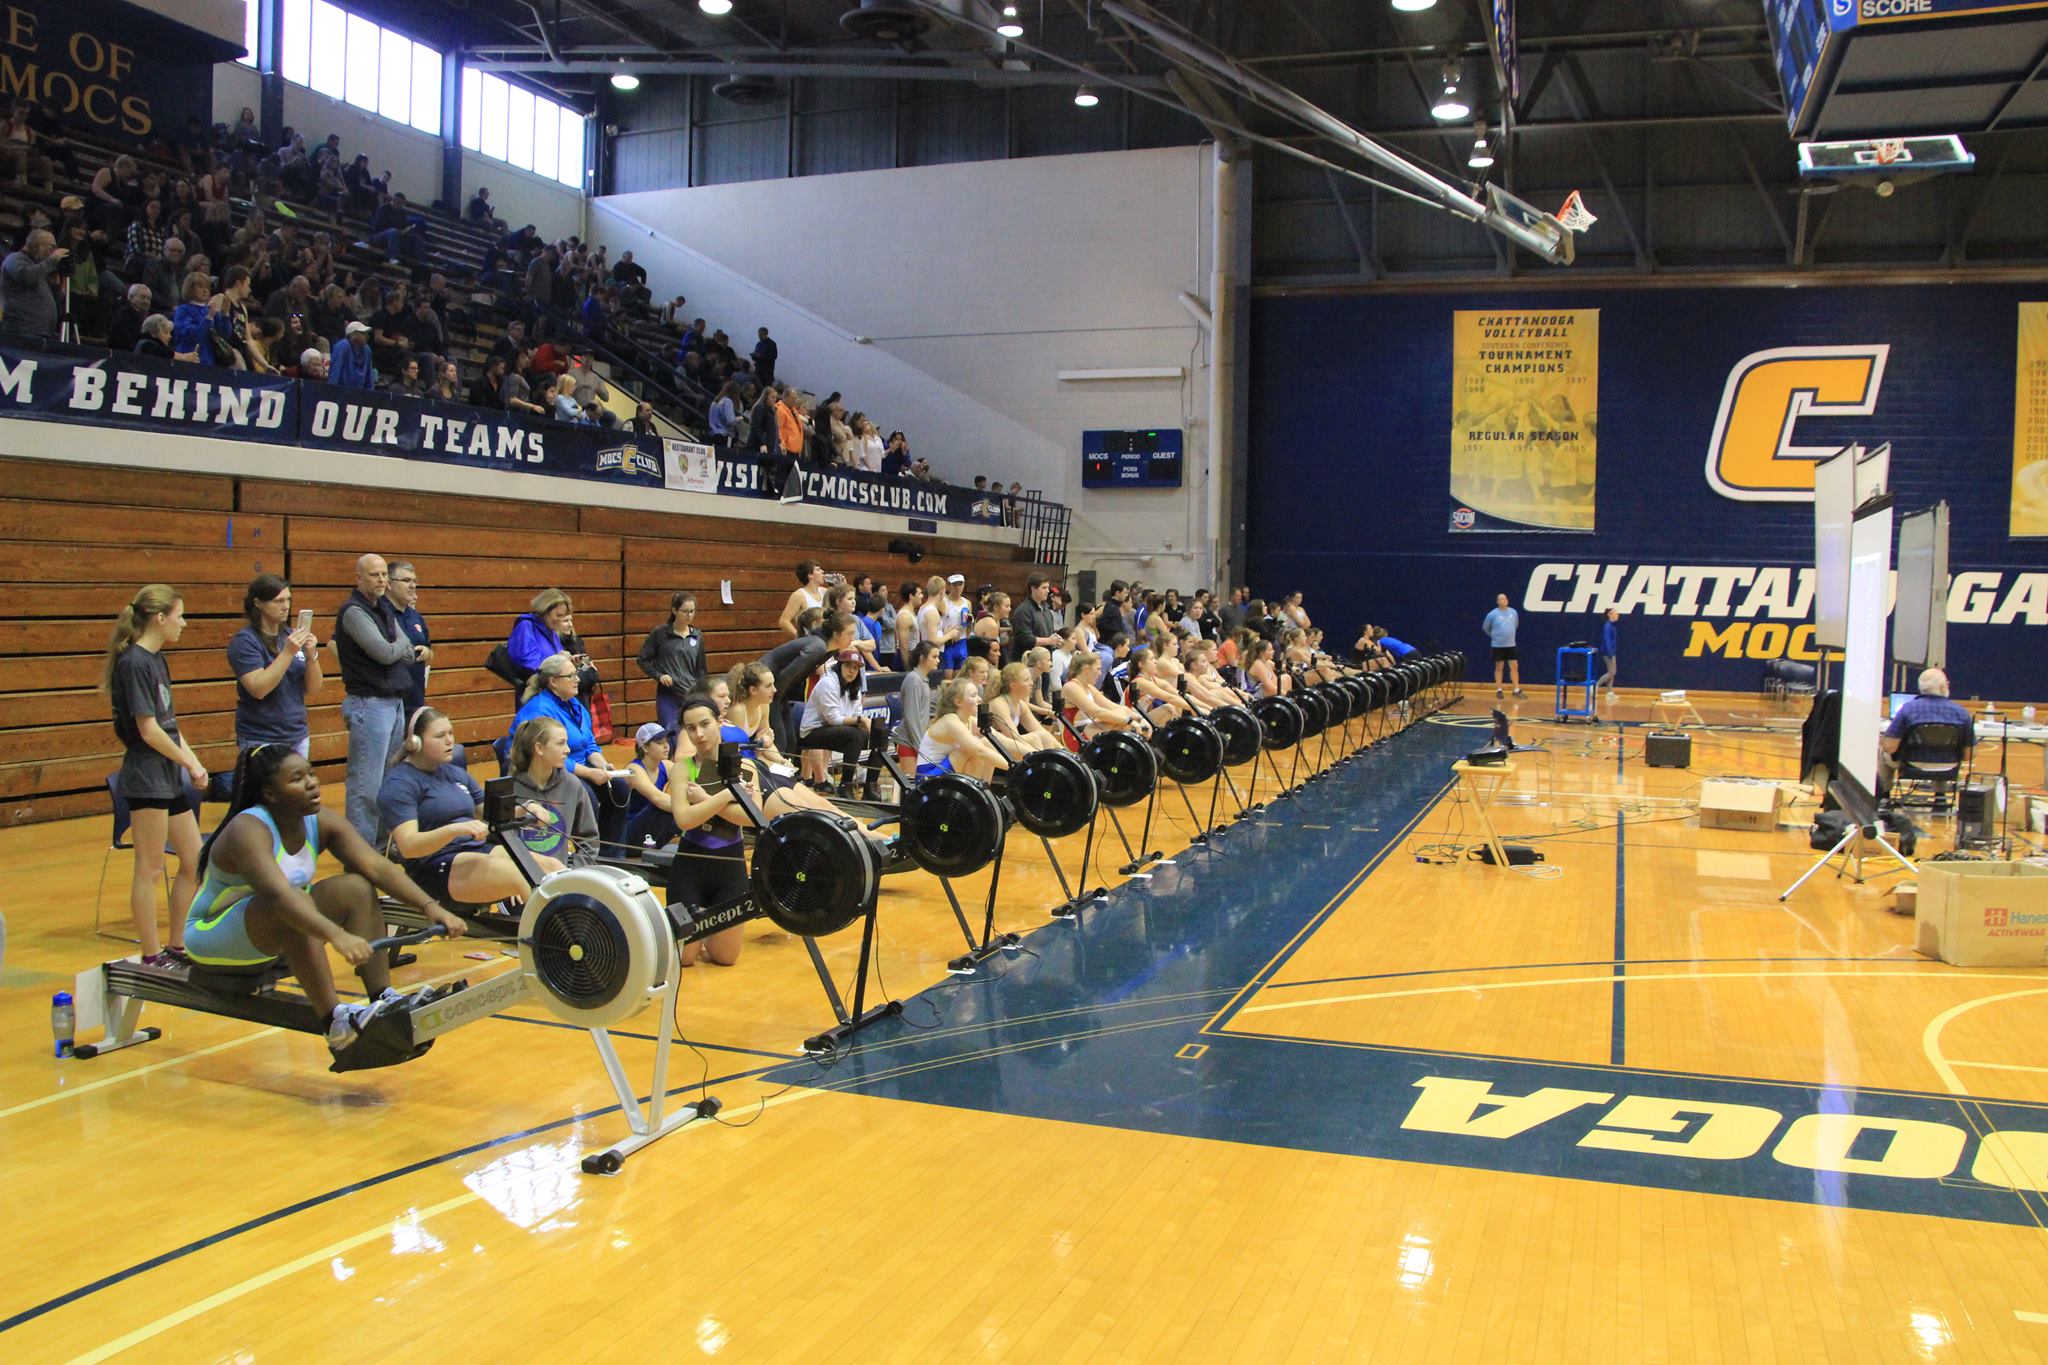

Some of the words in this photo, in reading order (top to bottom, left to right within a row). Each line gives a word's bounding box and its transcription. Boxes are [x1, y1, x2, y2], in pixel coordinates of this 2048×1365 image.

[1862, 0, 1932, 17] SCORE
[69, 32, 135, 81] OF
[0, 54, 152, 136] MOCS
[1478, 316, 1575, 326] CHATTANOOGA
[1484, 328, 1568, 338] VOLLEYBALL
[1478, 350, 1573, 360] TOURNAMENT
[1485, 363, 1565, 373] CHAMPIONS
[69, 366, 286, 429] BEHIND
[311, 401, 400, 445] OUR
[420, 414, 544, 464] TEAMS
[1469, 431, 1525, 441] REGULAR
[1530, 431, 1579, 441] SEASON
[600, 452, 622, 466] MOCS
[636, 454, 658, 473] CLUB
[1683, 621, 1846, 661] MOC
[745, 900, 754, 911] 2
[2010, 912, 2048, 924] Hanes
[1988, 929, 2046, 937] ACTIVEWEAR
[443, 981, 516, 1020] concept
